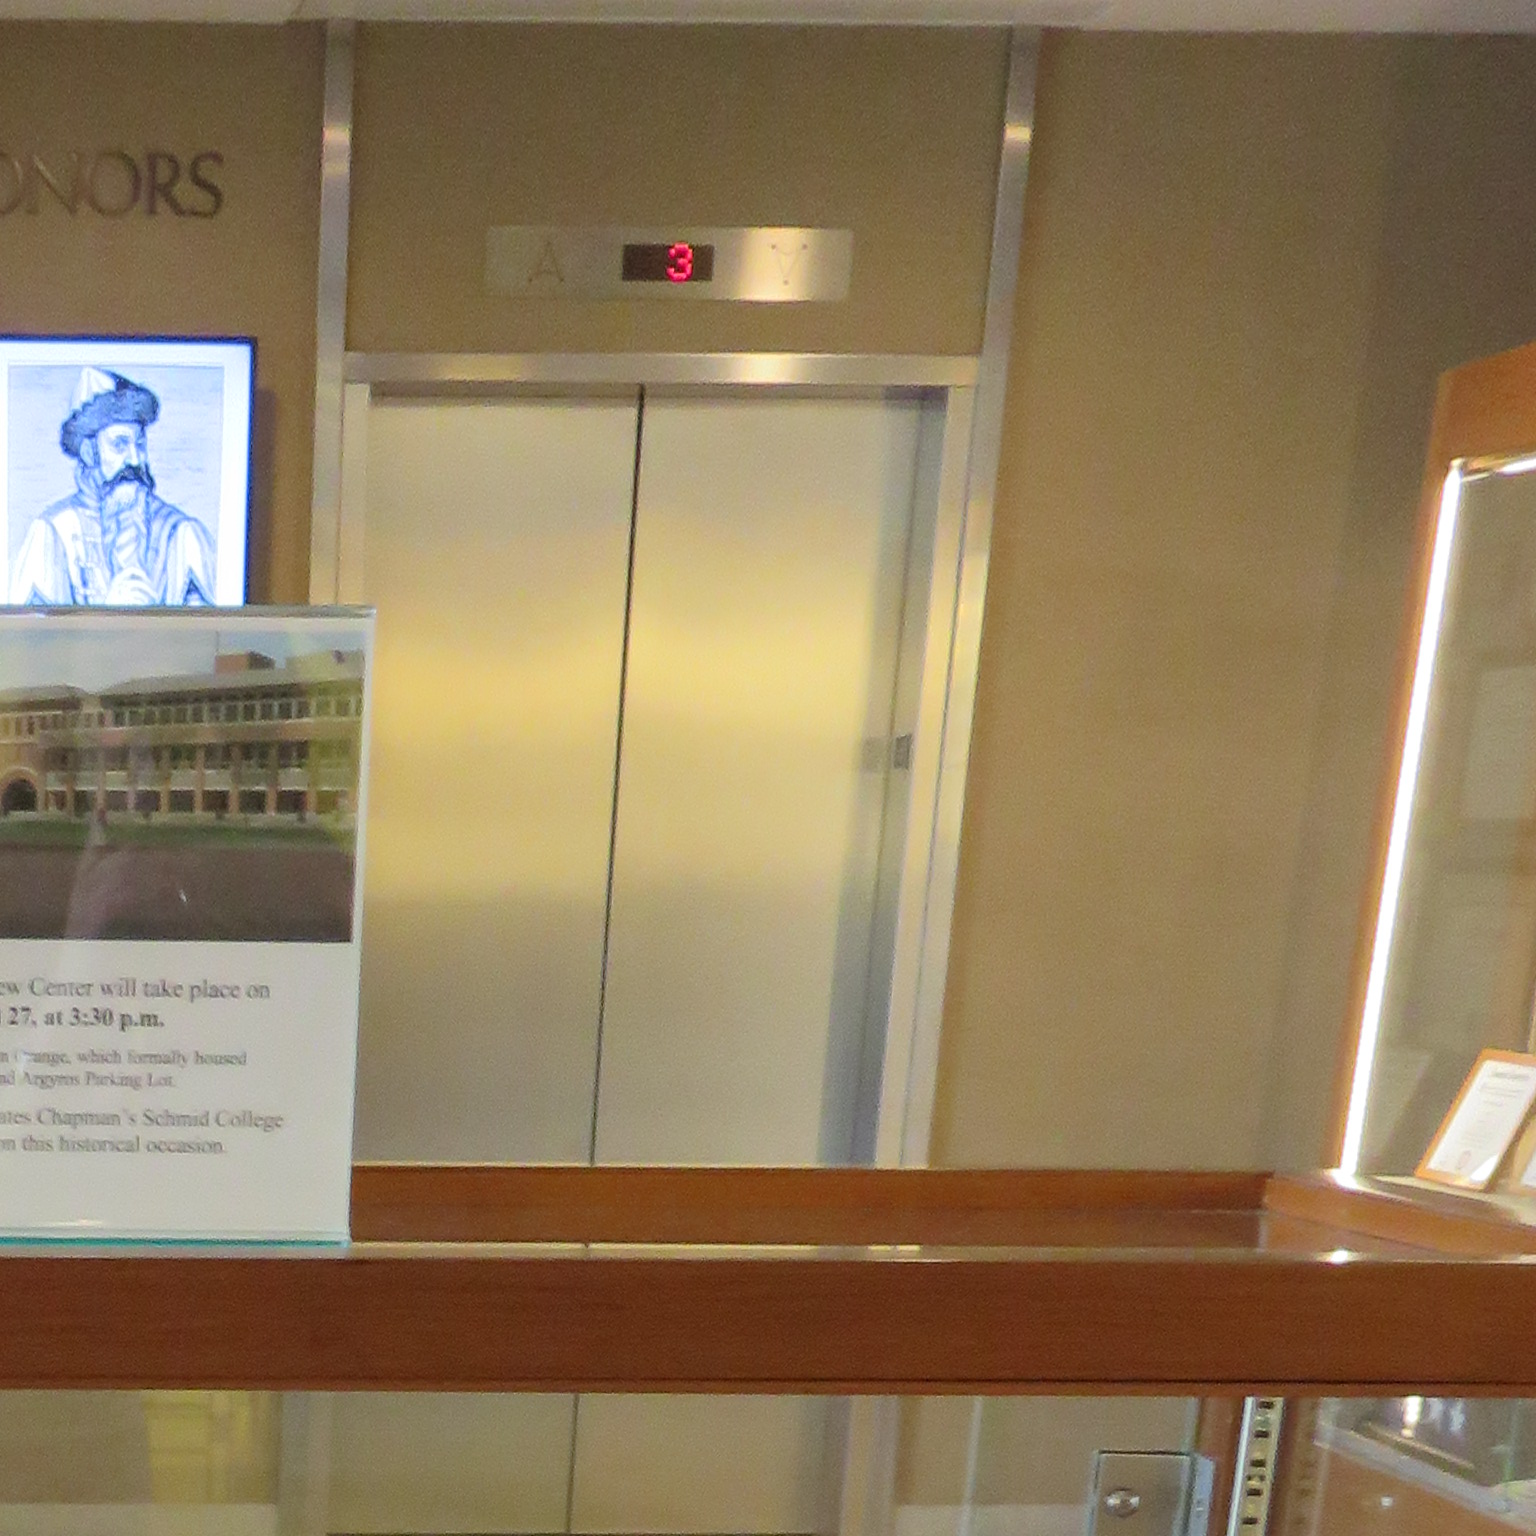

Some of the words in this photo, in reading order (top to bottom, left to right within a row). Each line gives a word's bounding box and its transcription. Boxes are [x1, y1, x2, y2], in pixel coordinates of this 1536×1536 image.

[666, 241, 693, 283] 3
[29, 977, 94, 997] Center
[100, 978, 137, 997] will
[143, 979, 184, 998] take
[189, 979, 240, 1003] place
[246, 984, 271, 999] on
[7, 1007, 37, 1027] 27,
[44, 1010, 63, 1027] at
[69, 1008, 114, 1027] 3:30
[119, 1011, 165, 1032] p.m.
[15, 1050, 71, 1067] ange,
[77, 1050, 121, 1065] which
[127, 1050, 188, 1068] formally
[194, 1051, 247, 1066] housed
[85, 1072, 142, 1091] Parking
[37, 1108, 136, 1128] Chapman's
[143, 1109, 210, 1128] Schmid
[214, 1111, 284, 1132] College
[22, 1136, 54, 1151] this
[59, 1136, 140, 1152] historical
